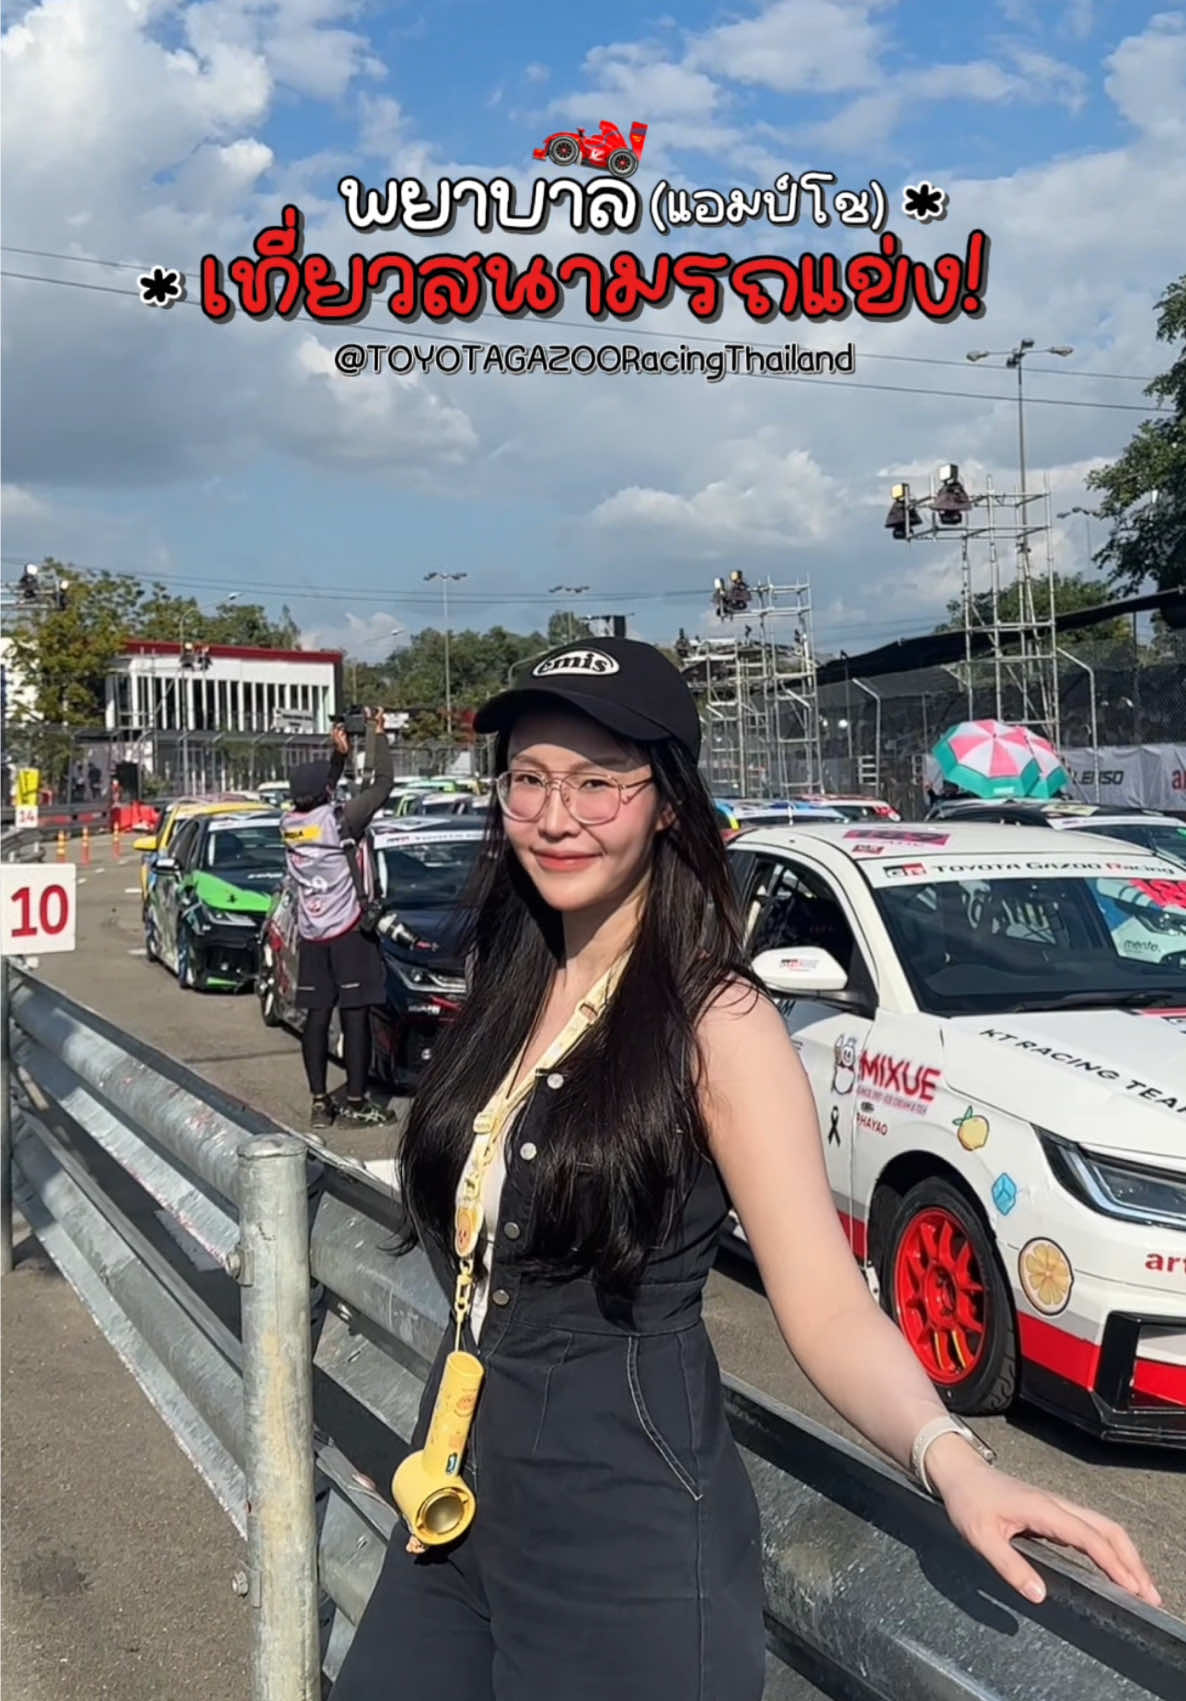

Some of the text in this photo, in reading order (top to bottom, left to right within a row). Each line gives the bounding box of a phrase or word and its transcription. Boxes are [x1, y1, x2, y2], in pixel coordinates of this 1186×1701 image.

[537, 652, 608, 674] emis
[934, 863, 1021, 874] TOYOTA
[1026, 861, 1102, 871] GAZOO
[11, 884, 69, 937] 10
[859, 1049, 941, 1102] MIXUE
[979, 1028, 1018, 1042] KT
[1015, 1040, 1121, 1081] RACING
